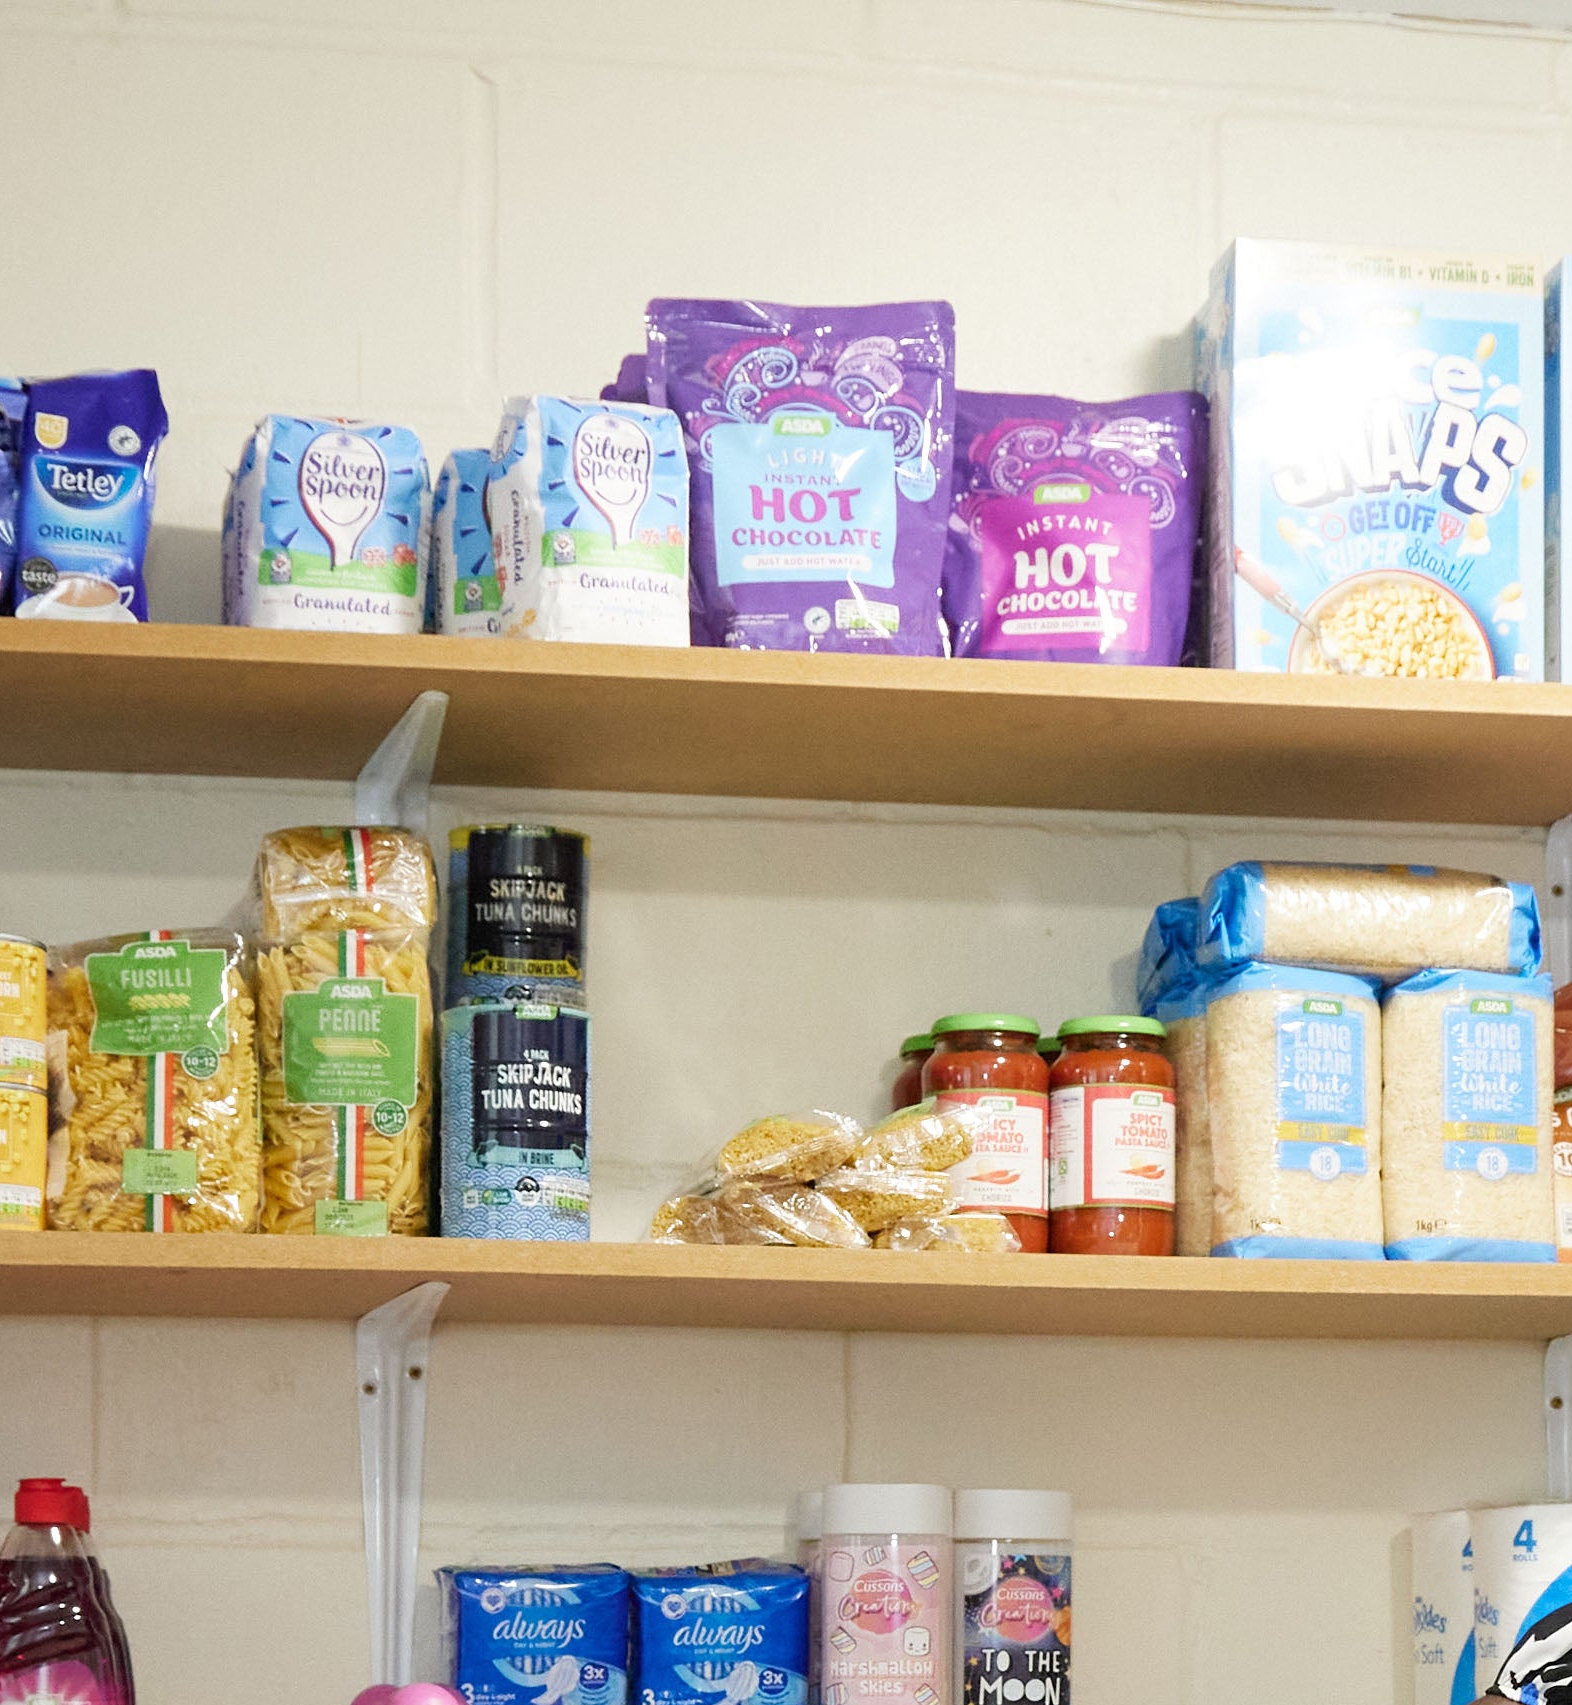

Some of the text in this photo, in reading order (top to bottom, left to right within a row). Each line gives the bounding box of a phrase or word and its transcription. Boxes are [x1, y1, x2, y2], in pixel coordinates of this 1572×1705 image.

[1429, 267, 1477, 283] VITAMIN
[781, 418, 825, 434] ASDA
[580, 432, 646, 464] Silver
[46, 463, 125, 501] Tetley
[303, 453, 381, 491] Silver
[580, 458, 646, 486] Spoon
[305, 475, 380, 508] Spoon
[1041, 487, 1083, 500] ASDA
[749, 484, 862, 523] HOT
[1017, 514, 1113, 541] INSTANT
[1348, 501, 1437, 535] GET OFF
[39, 524, 126, 546] ORIGINAL
[732, 526, 882, 550] CHOCOLATE
[22, 569, 57, 585] taste
[1013, 543, 1120, 589] HOT
[294, 593, 392, 616] Granulated
[996, 588, 1138, 616] CHOCOLATE
[490, 878, 567, 902] SKIPJACK
[475, 902, 578, 928] TUNA CHUNKS
[134, 946, 177, 959] ASDA
[120, 968, 192, 989] FUSILLI
[330, 985, 373, 999] ASDA
[1308, 1001, 1338, 1014] ASDA
[1476, 1000, 1508, 1014] ASDA
[1293, 1023, 1351, 1051] LONG
[1459, 1022, 1521, 1050] LONG
[186, 1055, 216, 1068] 10-12
[1293, 1050, 1352, 1075] GRAIN
[1459, 1049, 1522, 1074] GRAIN
[496, 1063, 572, 1089] SKIPJACK
[1292, 1073, 1352, 1095] White
[1459, 1073, 1522, 1095] White
[481, 1089, 583, 1115] TUNA CHUNKS
[1304, 1093, 1345, 1112] RICE
[1472, 1094, 1514, 1112] RICE
[376, 1112, 404, 1124] 10-12
[1129, 1112, 1163, 1127] SPICY
[1114, 1137, 1142, 1147] PASTA
[1120, 1125, 1168, 1140] TOMATO
[530, 1152, 554, 1166] BRINE
[1320, 1155, 1333, 1171] 18
[1486, 1155, 1499, 1171] 18
[1416, 1219, 1433, 1233] 1kg
[1513, 1520, 1538, 1553] 4
[1513, 1554, 1538, 1562] ROLLS
[854, 1579, 906, 1593] Cussons
[996, 1588, 1045, 1601] Cussons
[493, 1611, 587, 1649] always
[673, 1617, 766, 1654] always
[983, 1649, 1060, 1673] TO THE
[583, 1664, 605, 1681] 3x
[762, 1670, 784, 1687] 3x
[859, 1679, 904, 1696] Skies
[979, 1677, 1061, 1705] MOON
